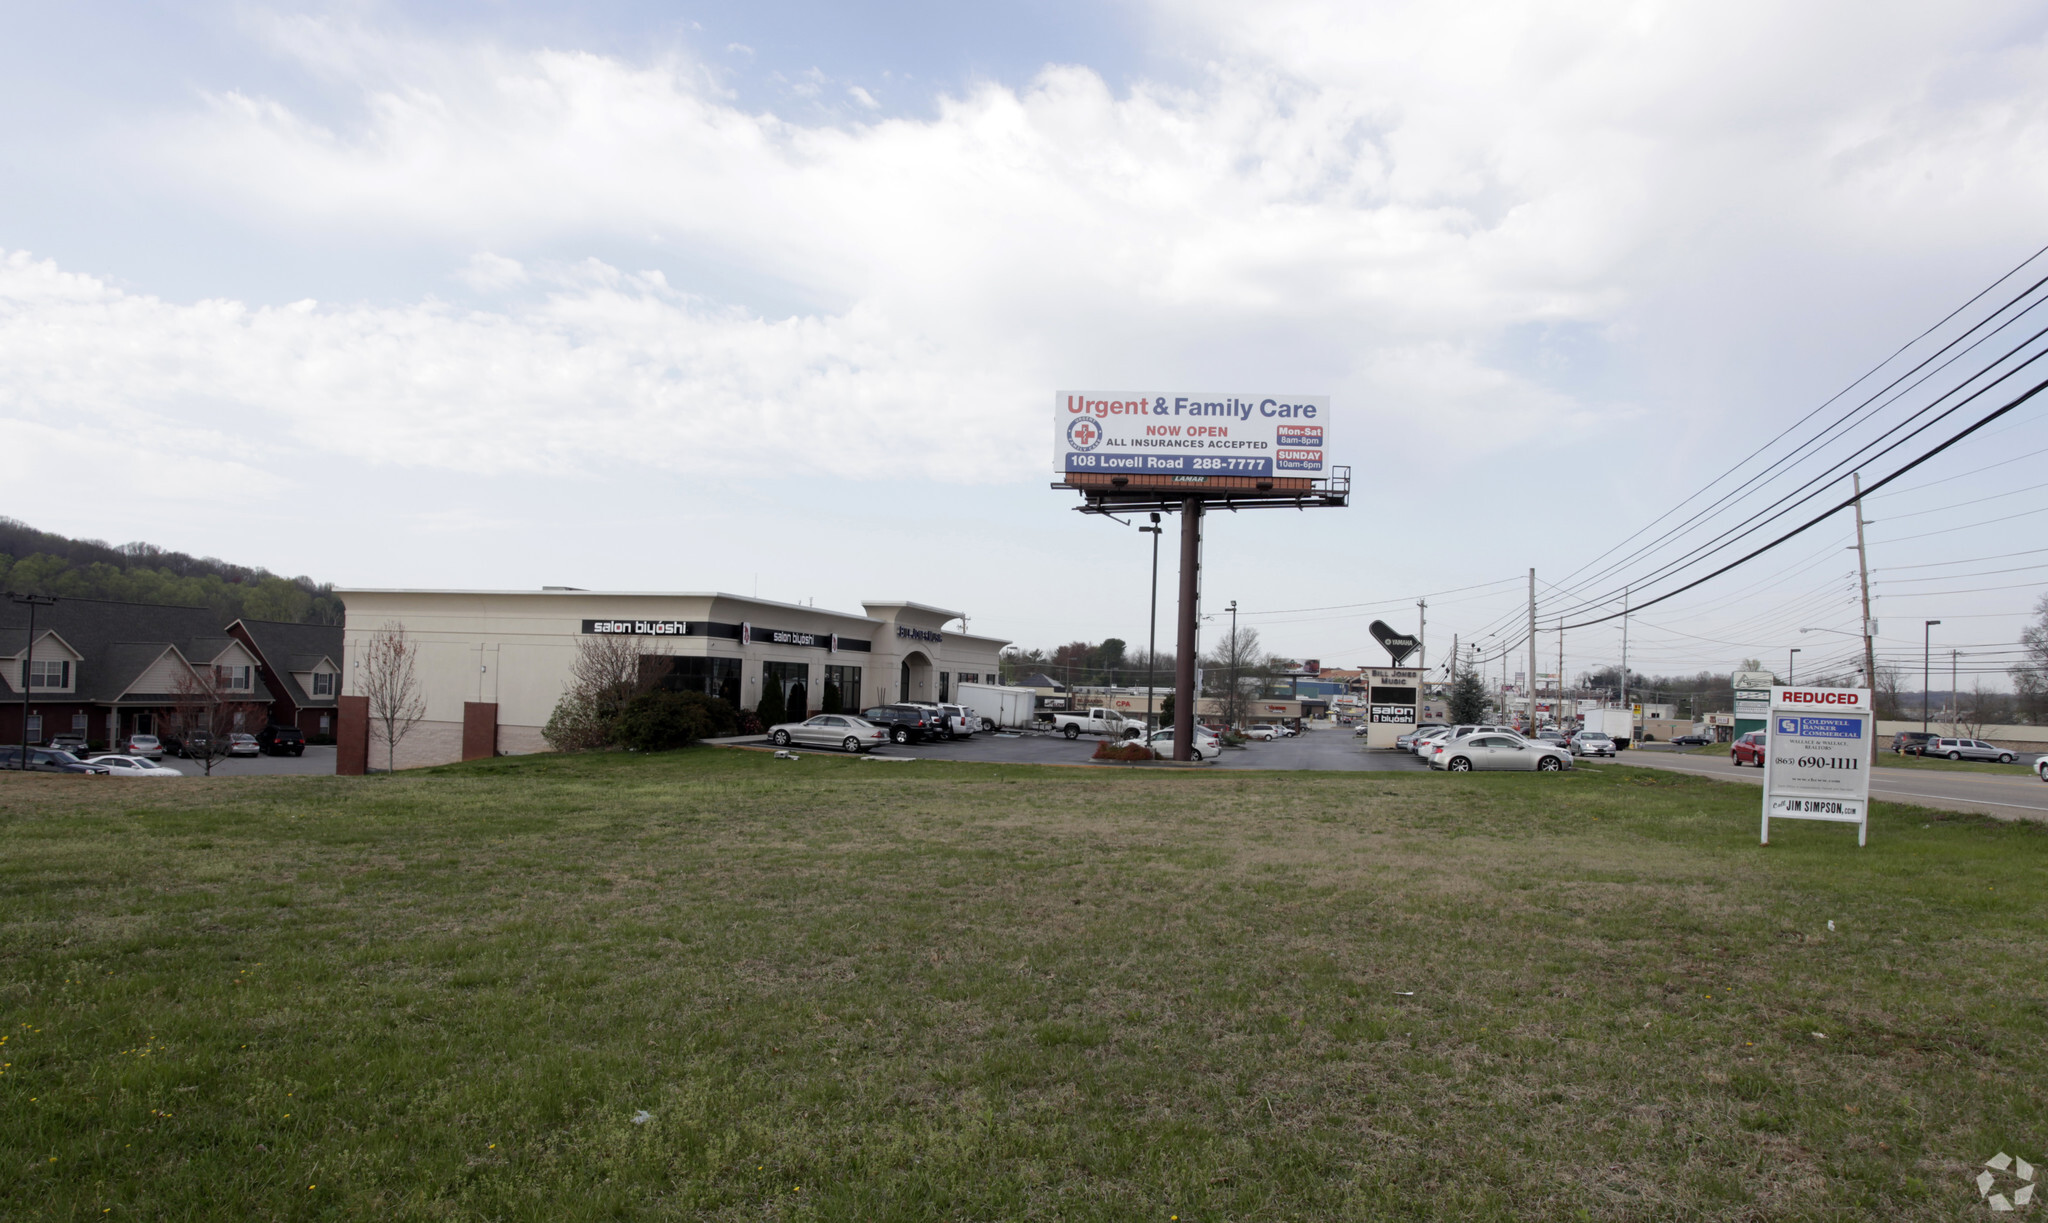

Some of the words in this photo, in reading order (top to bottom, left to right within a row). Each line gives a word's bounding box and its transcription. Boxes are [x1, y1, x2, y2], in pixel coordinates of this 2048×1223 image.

[1068, 395, 1148, 418] Urgent
[1153, 396, 1170, 416] &
[1175, 397, 1253, 421] Family
[1260, 399, 1317, 418] Care
[1146, 425, 1181, 436] NOW
[1187, 426, 1228, 437] OPEN
[1278, 427, 1321, 437] Mon-Sat
[1106, 438, 1127, 447] ALL
[1131, 439, 1204, 448] INSURANCES
[1208, 440, 1268, 449] ACCEPTED
[1281, 436, 1319, 445] 8am-8pm
[1278, 451, 1321, 460] SUNDAY
[1071, 455, 1096, 467] 108
[1100, 455, 1142, 468] Lovell
[1147, 457, 1183, 469] Road
[1192, 458, 1265, 470] 288-7777
[1279, 460, 1321, 469] 10am-6pm
[594, 620, 631, 633] salon
[773, 631, 791, 643] salon
[1391, 638, 1413, 646] YAMAHA
[1372, 670, 1389, 678] BILL
[1391, 670, 1417, 678] JONES
[1381, 677, 1407, 685] MUSIC
[1782, 691, 1859, 705] REDUCED
[1116, 700, 1131, 708] CPA
[1372, 706, 1413, 715] salon
[1802, 718, 1850, 726] COLDWELL
[1802, 730, 1859, 738] COMMERCIAL
[1775, 756, 1795, 765] (865)
[1798, 756, 1859, 770] 690-1111
[1773, 800, 1786, 808] Call
[1786, 800, 1802, 811] JIM
